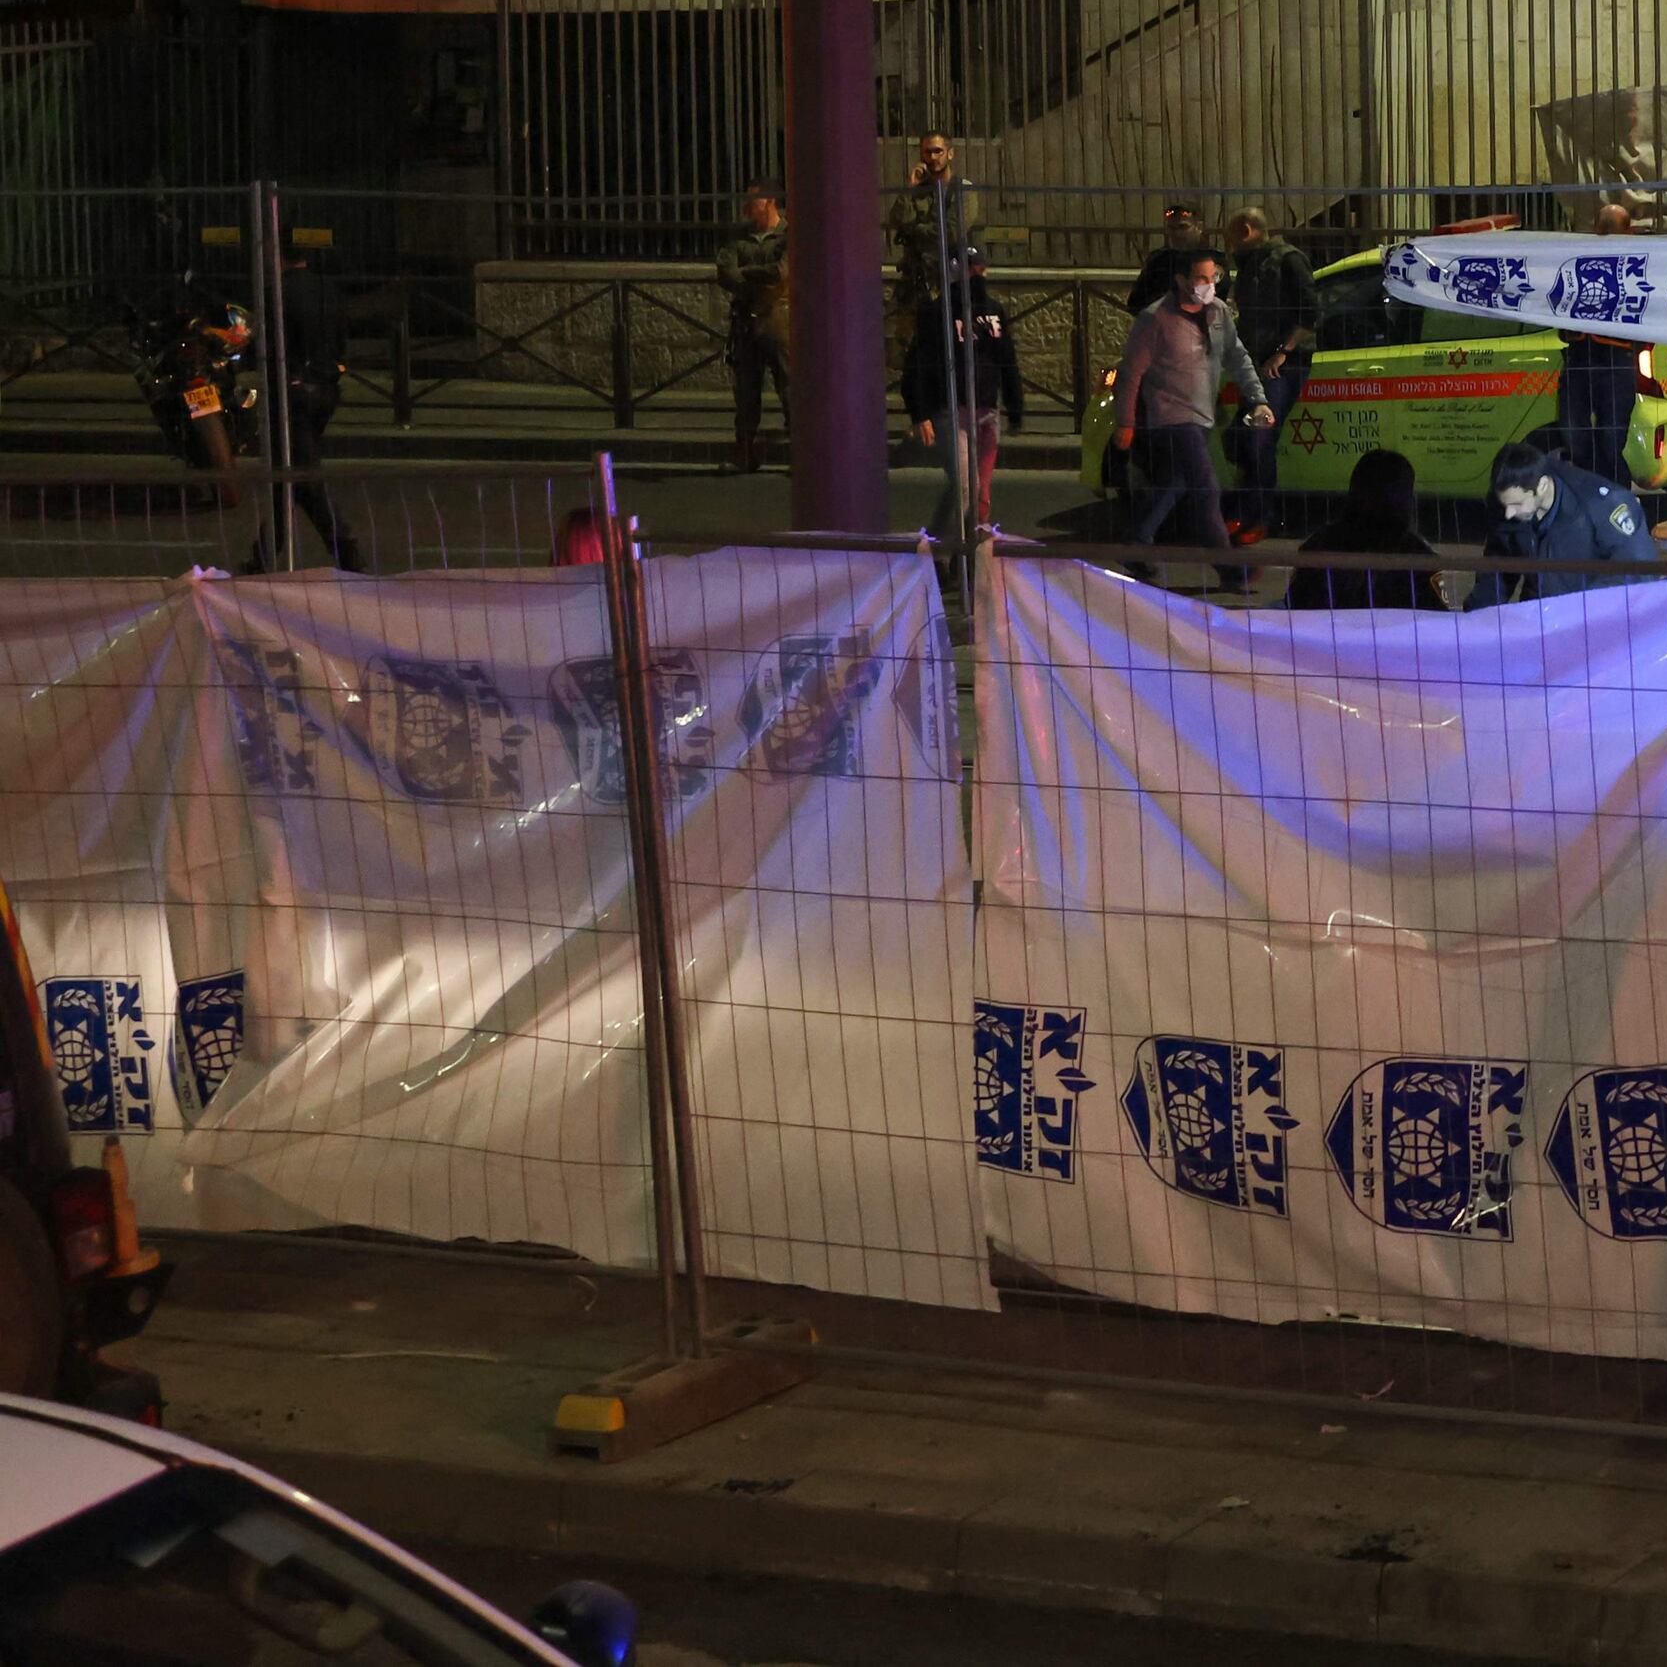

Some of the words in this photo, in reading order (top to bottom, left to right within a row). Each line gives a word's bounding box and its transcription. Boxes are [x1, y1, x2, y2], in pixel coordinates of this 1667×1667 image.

[1307, 384, 1336, 398] ADOM
[1350, 383, 1384, 396] ISRAEL
[1397, 382, 1437, 394] הלאומי
[1439, 381, 1477, 393] ההצלה
[1482, 379, 1510, 393] ארגון
[1333, 410, 1353, 423] דוד
[1348, 426, 1380, 439] אדום
[1359, 409, 1379, 425] מגן
[1023, 1008, 1038, 1061] הצלה
[115, 981, 156, 1131] זק"א
[1232, 1046, 1244, 1098] הצלה
[1020, 1066, 1036, 1116] חילוץ
[1033, 1011, 1096, 1179] זק"א
[1471, 1064, 1486, 1117] הצלה
[1361, 1092, 1375, 1127] אמת
[1576, 1101, 1592, 1138] אמת
[1231, 1103, 1246, 1153] חילוץ
[1245, 1050, 1300, 1215] זק"א
[1022, 1122, 1034, 1174] איתור
[1361, 1135, 1377, 1159] של
[1468, 1123, 1484, 1174] חילוץ
[1477, 1066, 1526, 1237] זק"א
[1581, 1145, 1597, 1170] של
[1362, 1167, 1375, 1198] חסד
[1586, 1178, 1600, 1210] חסד
